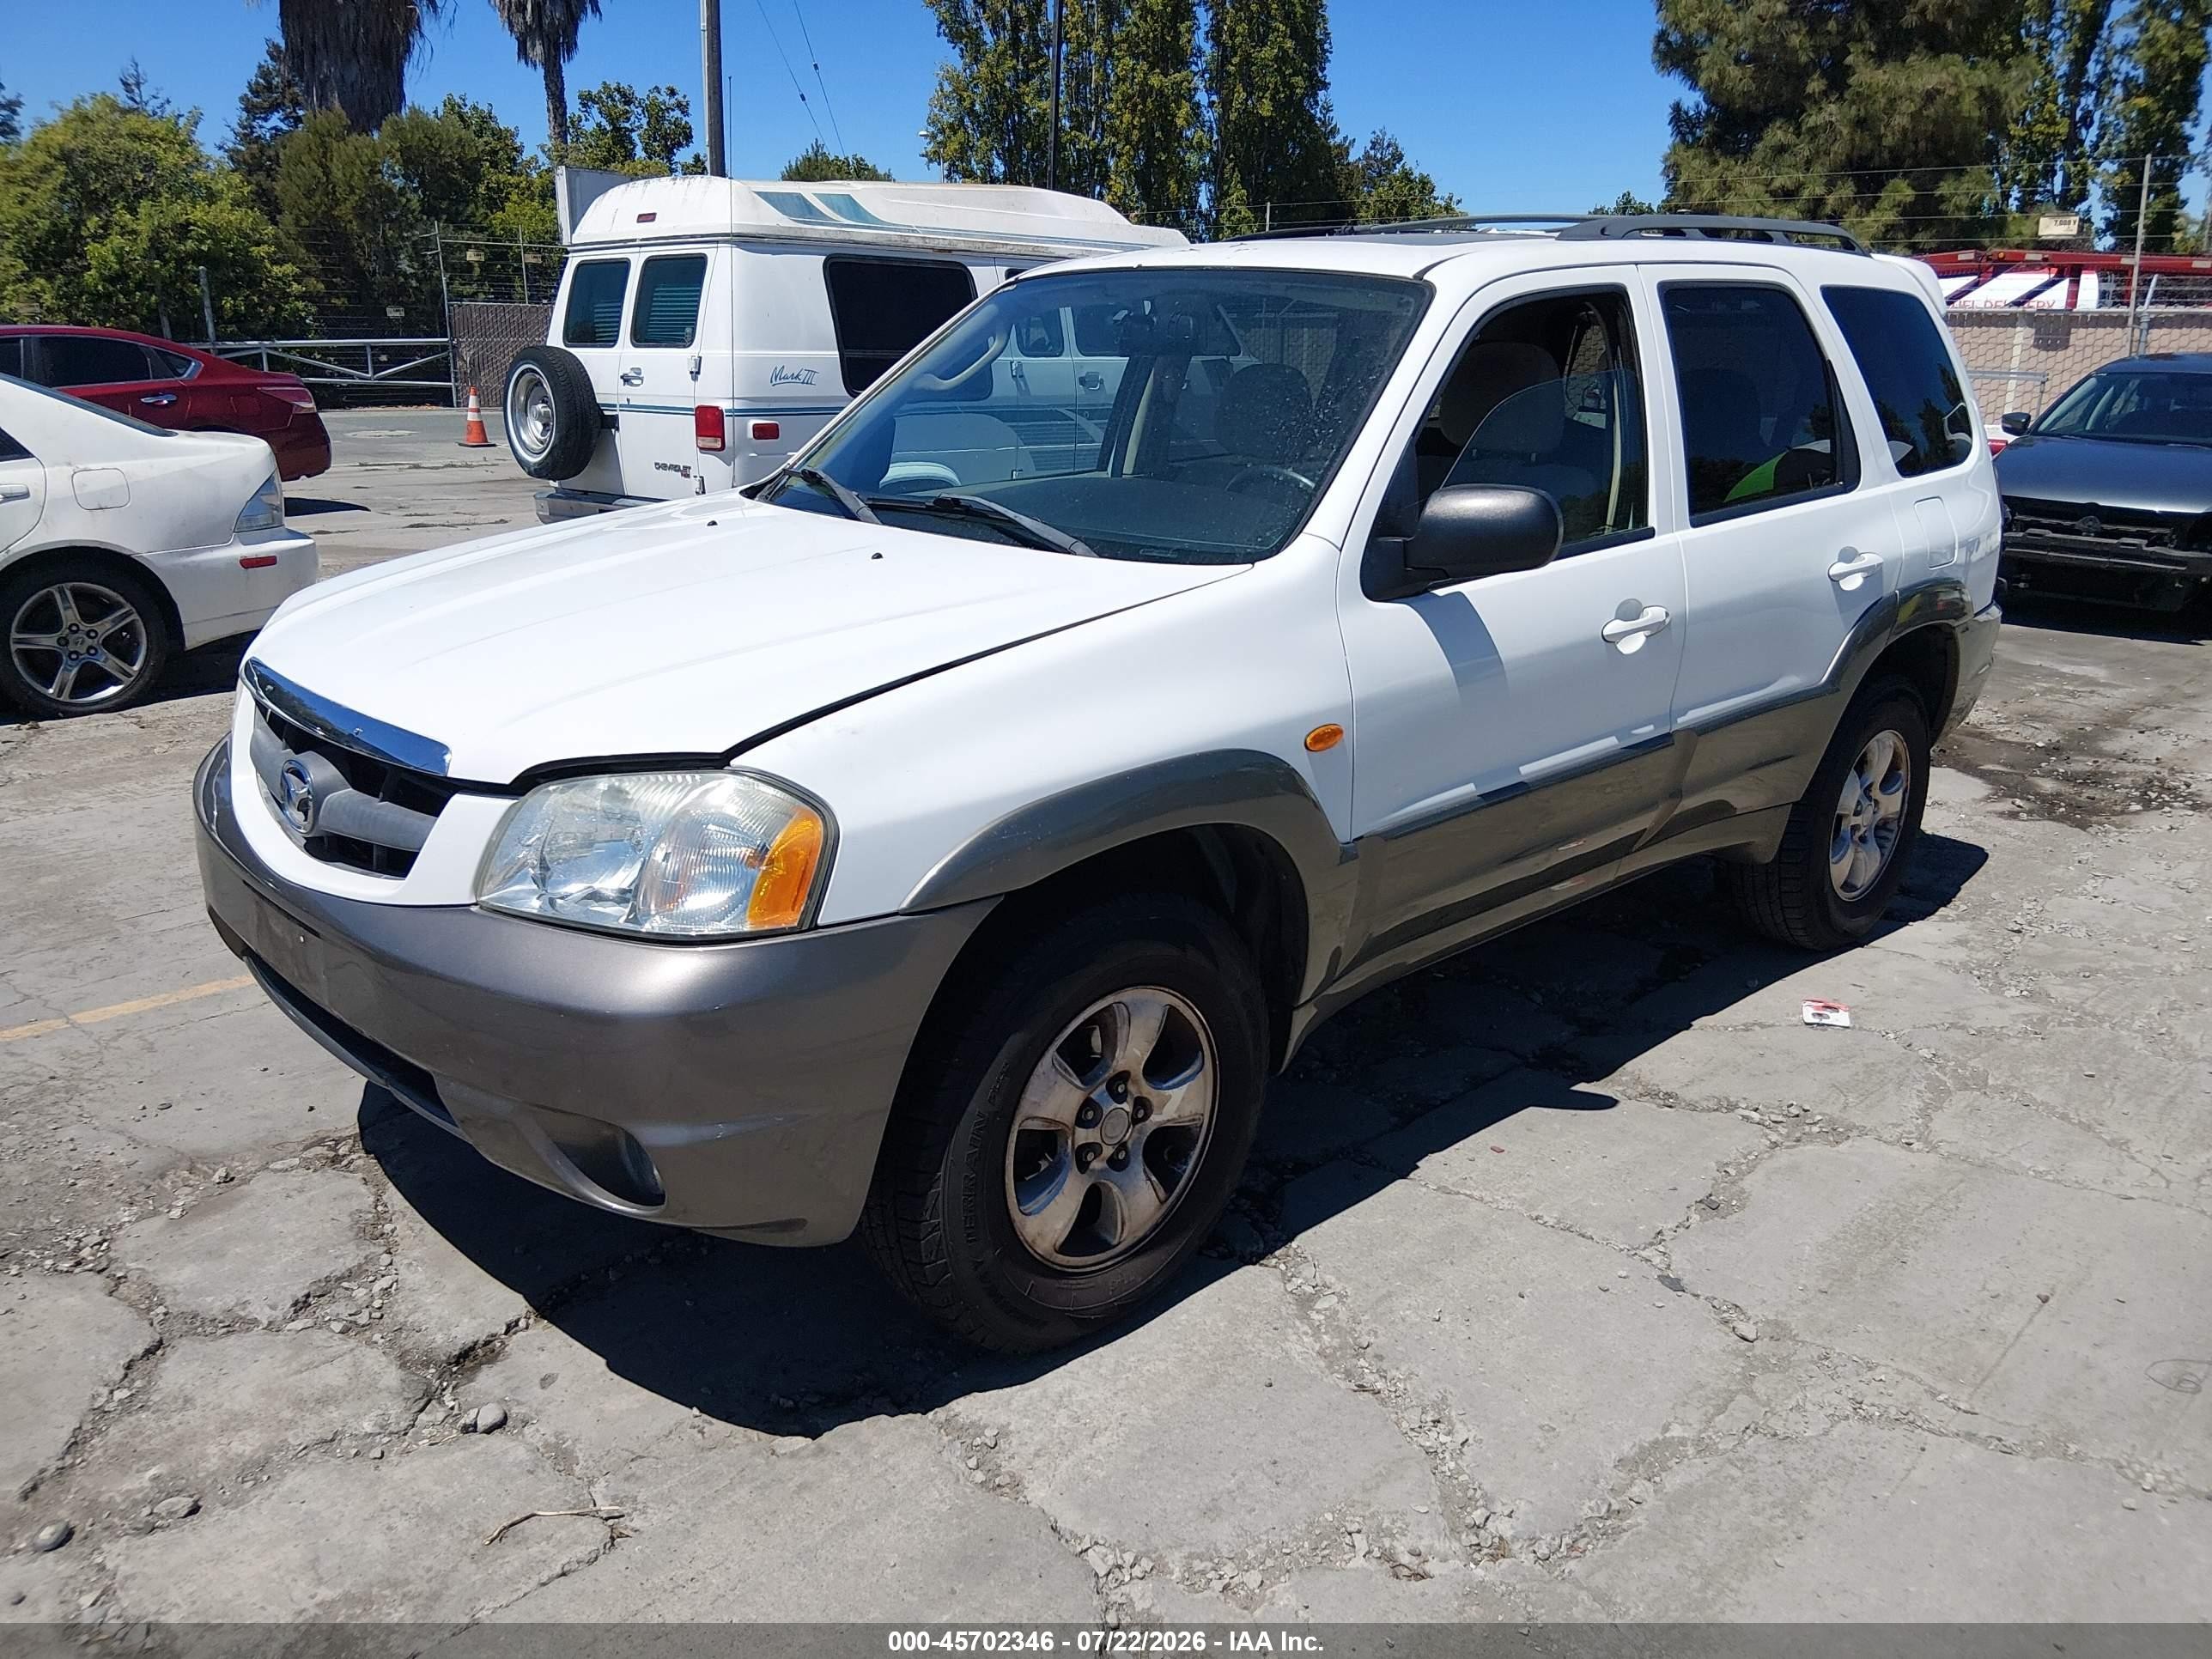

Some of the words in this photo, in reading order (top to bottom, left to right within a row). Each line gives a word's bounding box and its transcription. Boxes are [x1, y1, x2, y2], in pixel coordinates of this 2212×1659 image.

[1984, 300, 2056, 309] DELERY
[770, 365, 802, 384] Mark
[800, 369, 820, 385] III
